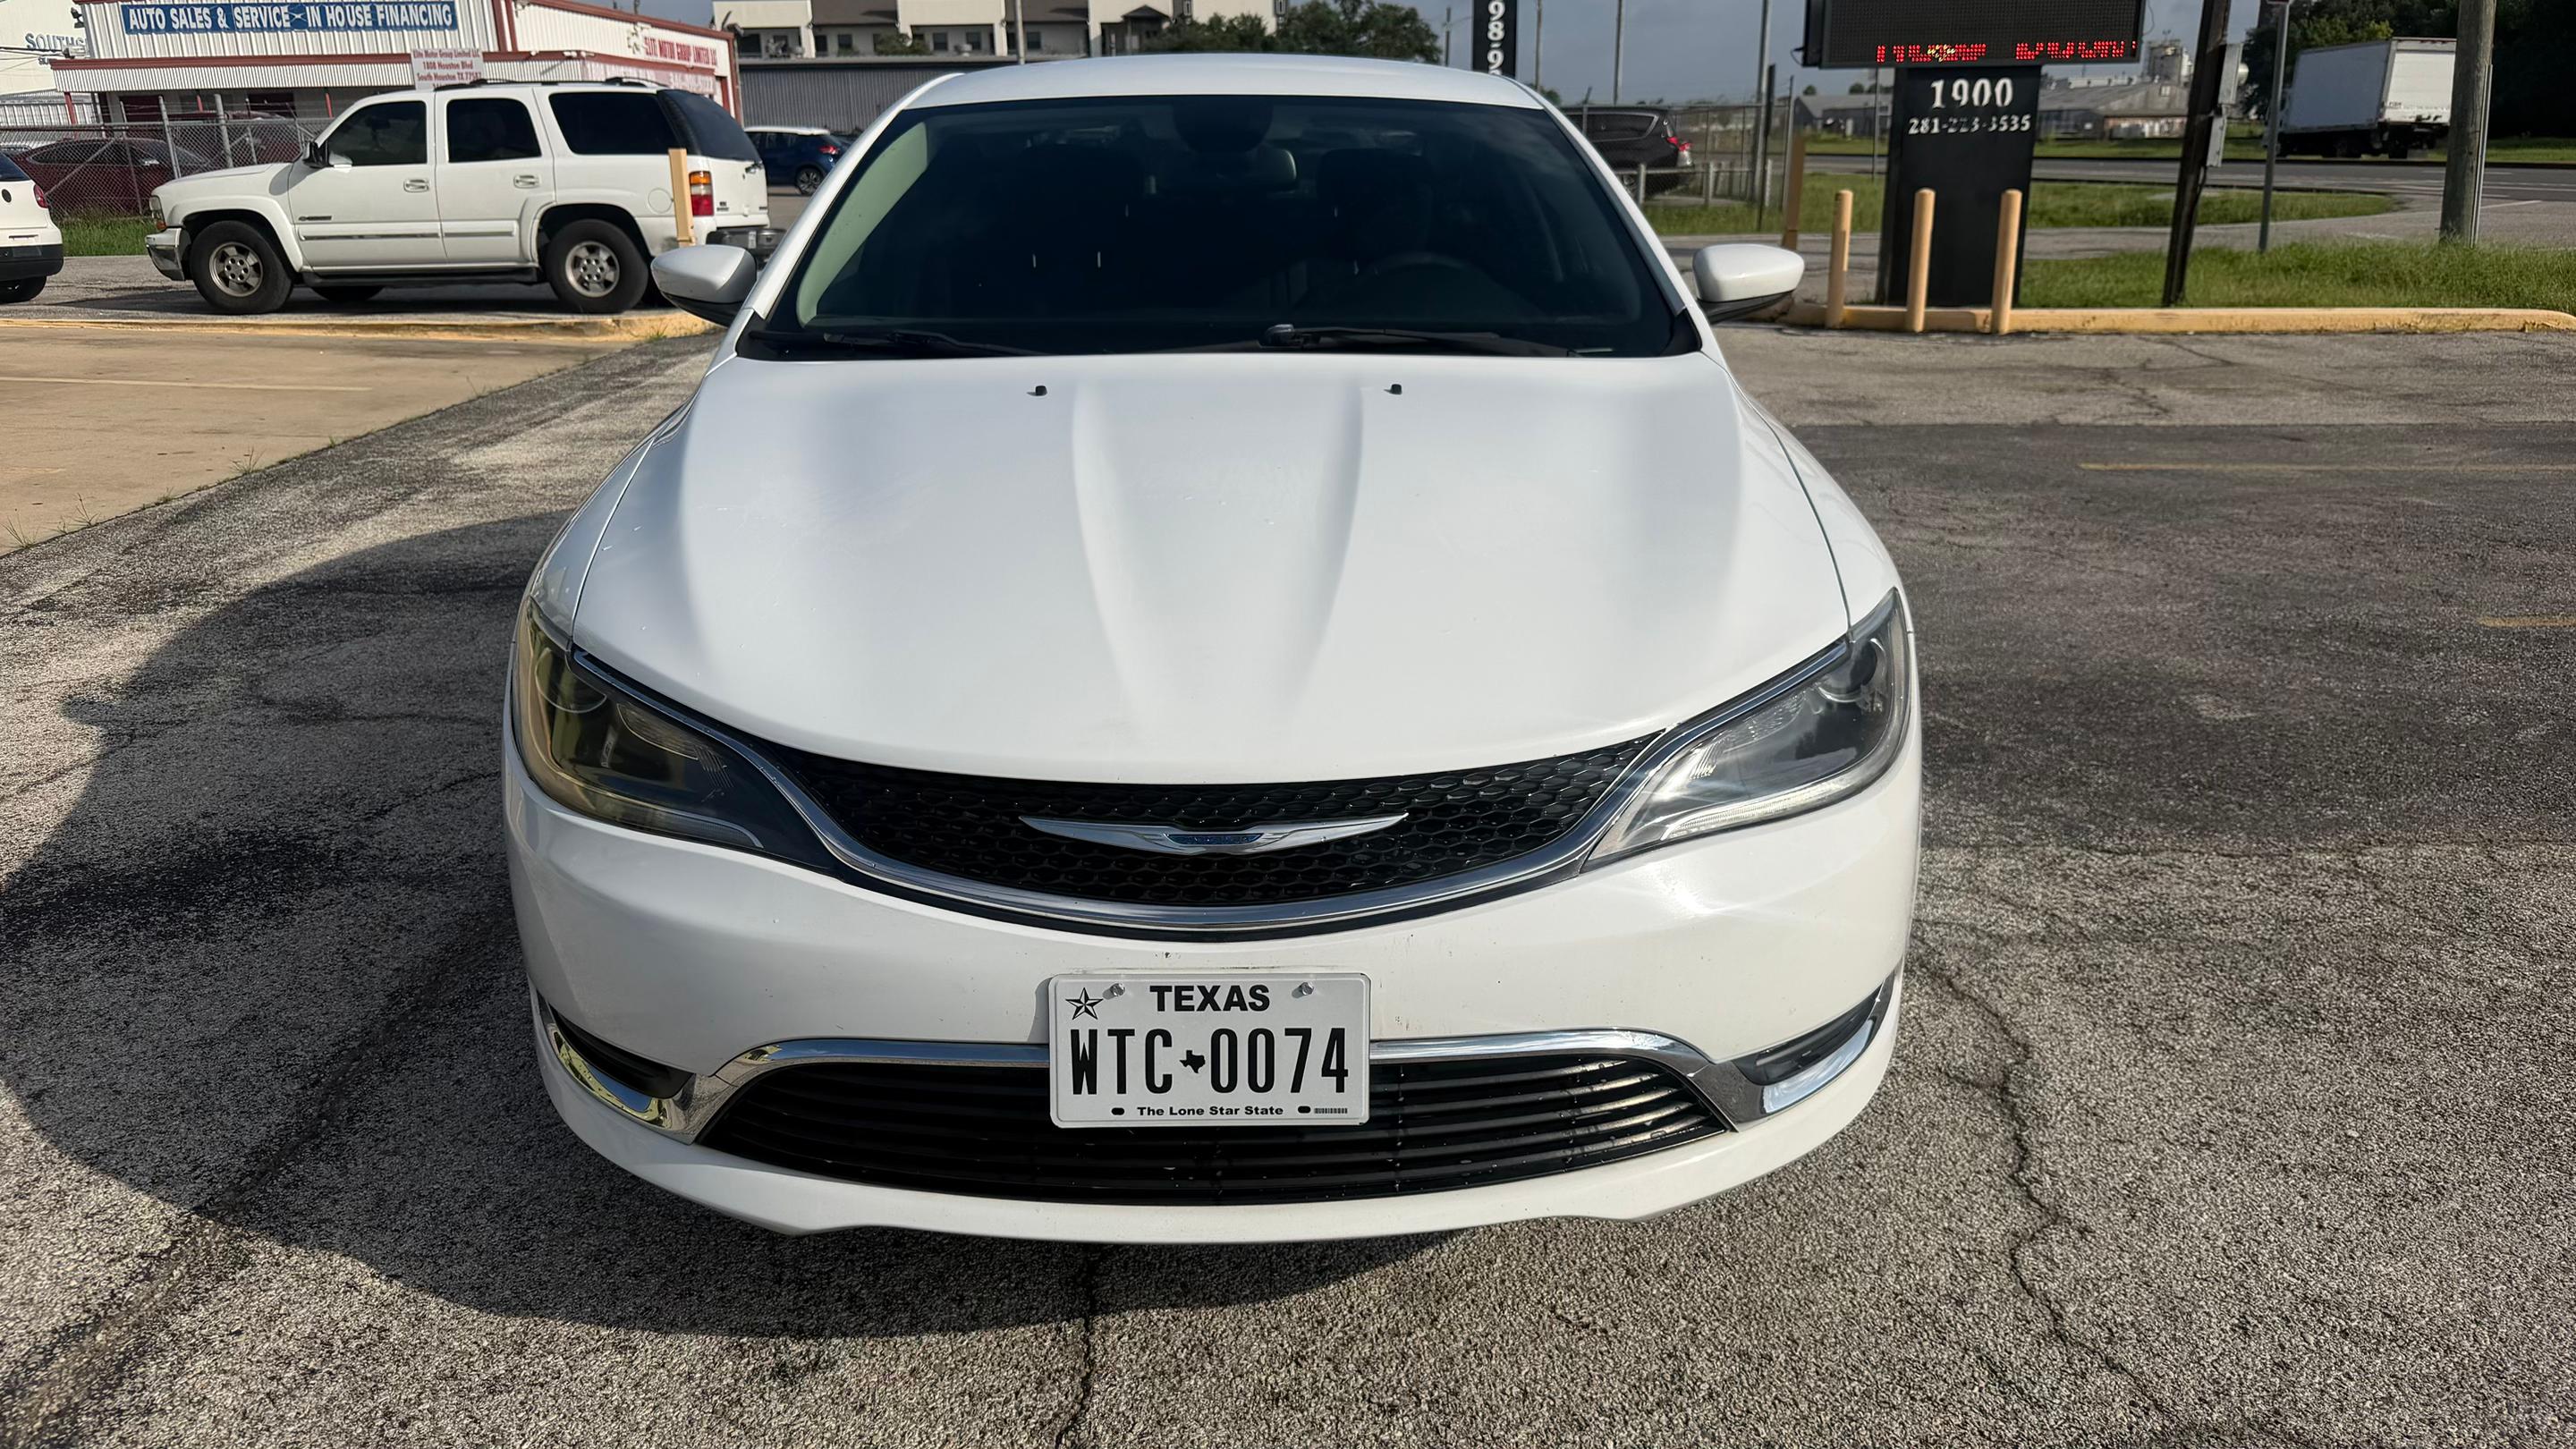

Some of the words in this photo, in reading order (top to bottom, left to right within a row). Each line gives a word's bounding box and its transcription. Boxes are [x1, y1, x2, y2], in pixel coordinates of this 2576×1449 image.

[129, 7, 166, 30] AUTO
[170, 6, 212, 30] SALES
[216, 6, 230, 29] &
[233, 5, 292, 28] SERVICE
[306, 5, 322, 28] IN
[325, 4, 373, 28] HOUSE
[375, 4, 453, 27] FINANCING
[1487, 0, 1505, 75] 98-9
[1930, 77, 2013, 108] 1900
[1149, 984, 1271, 1012] TEXAS
[1137, 1106, 1165, 1115] The
[1169, 1106, 1205, 1115] Lone
[1209, 1106, 1241, 1115] Star
[1244, 1106, 1284, 1115] State
